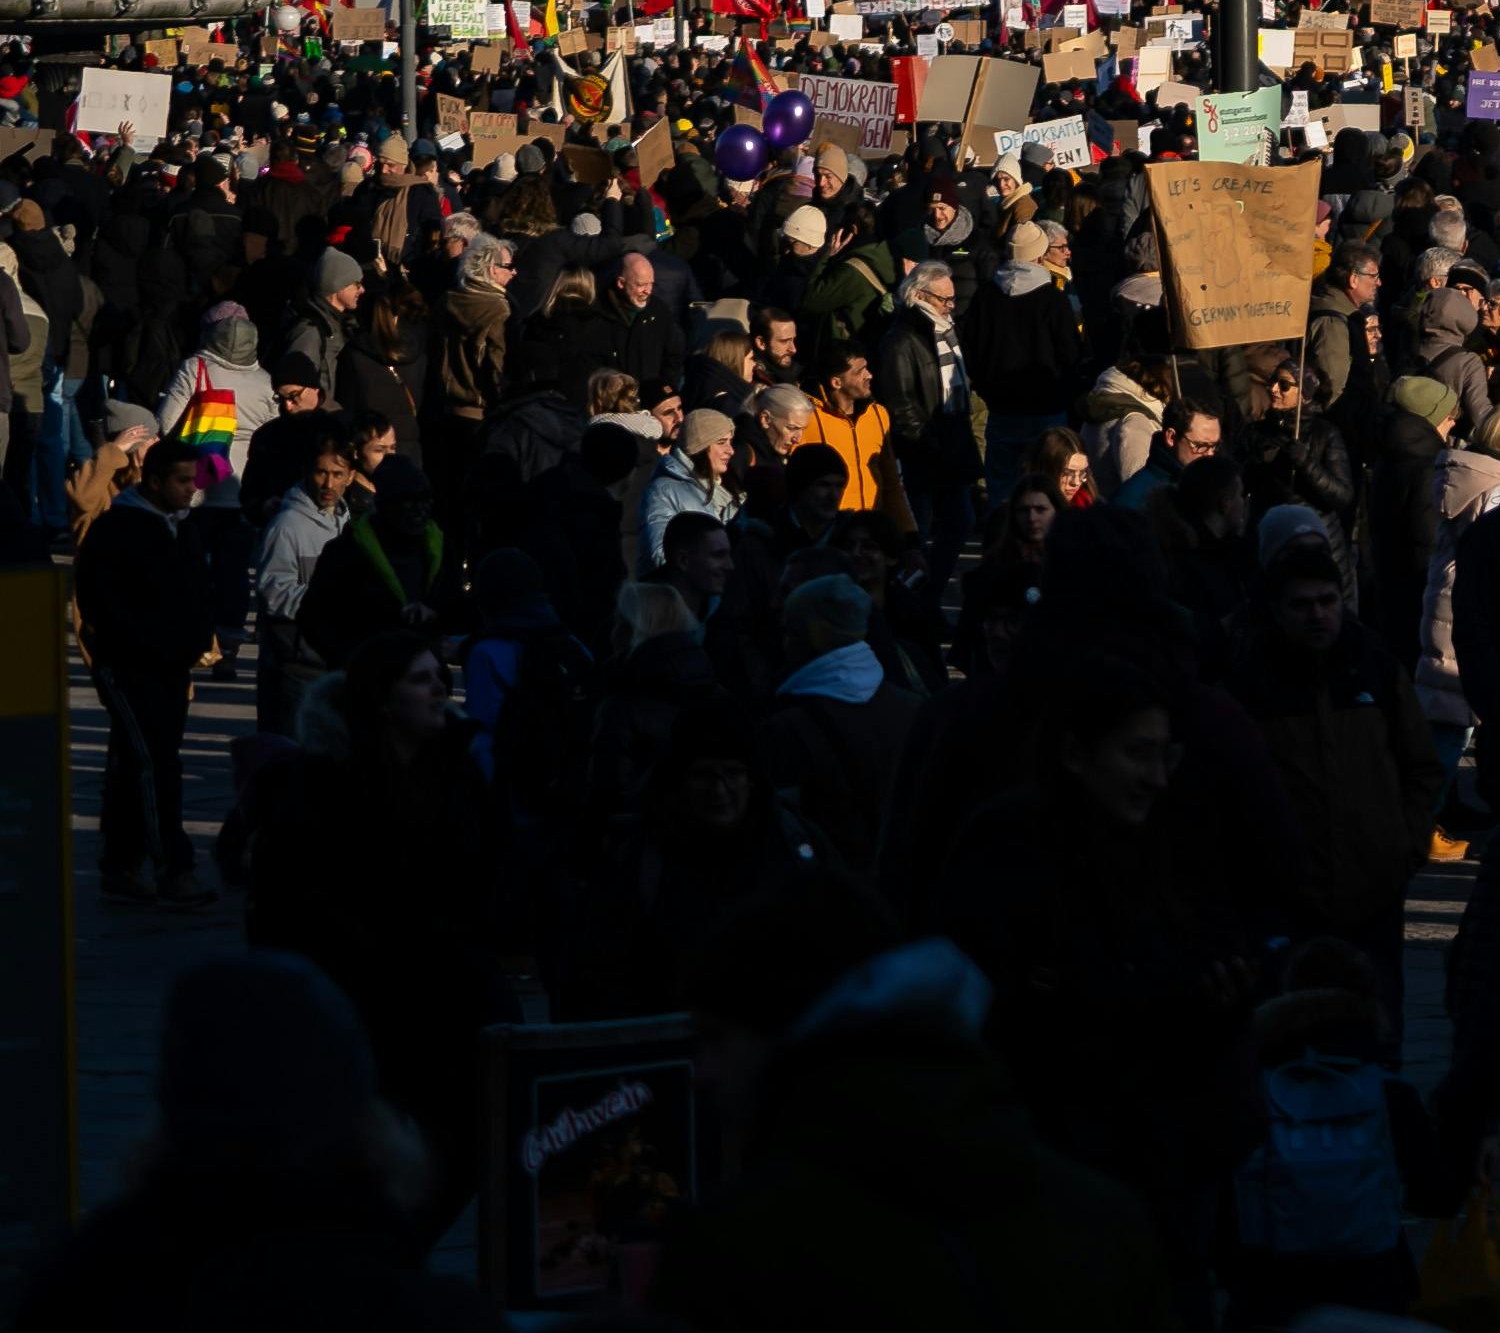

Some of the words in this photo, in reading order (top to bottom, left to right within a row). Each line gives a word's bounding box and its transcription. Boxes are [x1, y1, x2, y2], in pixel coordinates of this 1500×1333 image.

[800, 77, 898, 117] DEMOKRATIE
[1000, 120, 1086, 152] DEMOKRATIE
[1168, 177, 1201, 196] LET'S
[1212, 178, 1274, 194] CREATE
[1188, 305, 1241, 327] GERMANY
[1243, 300, 1292, 318] TOGETHER
